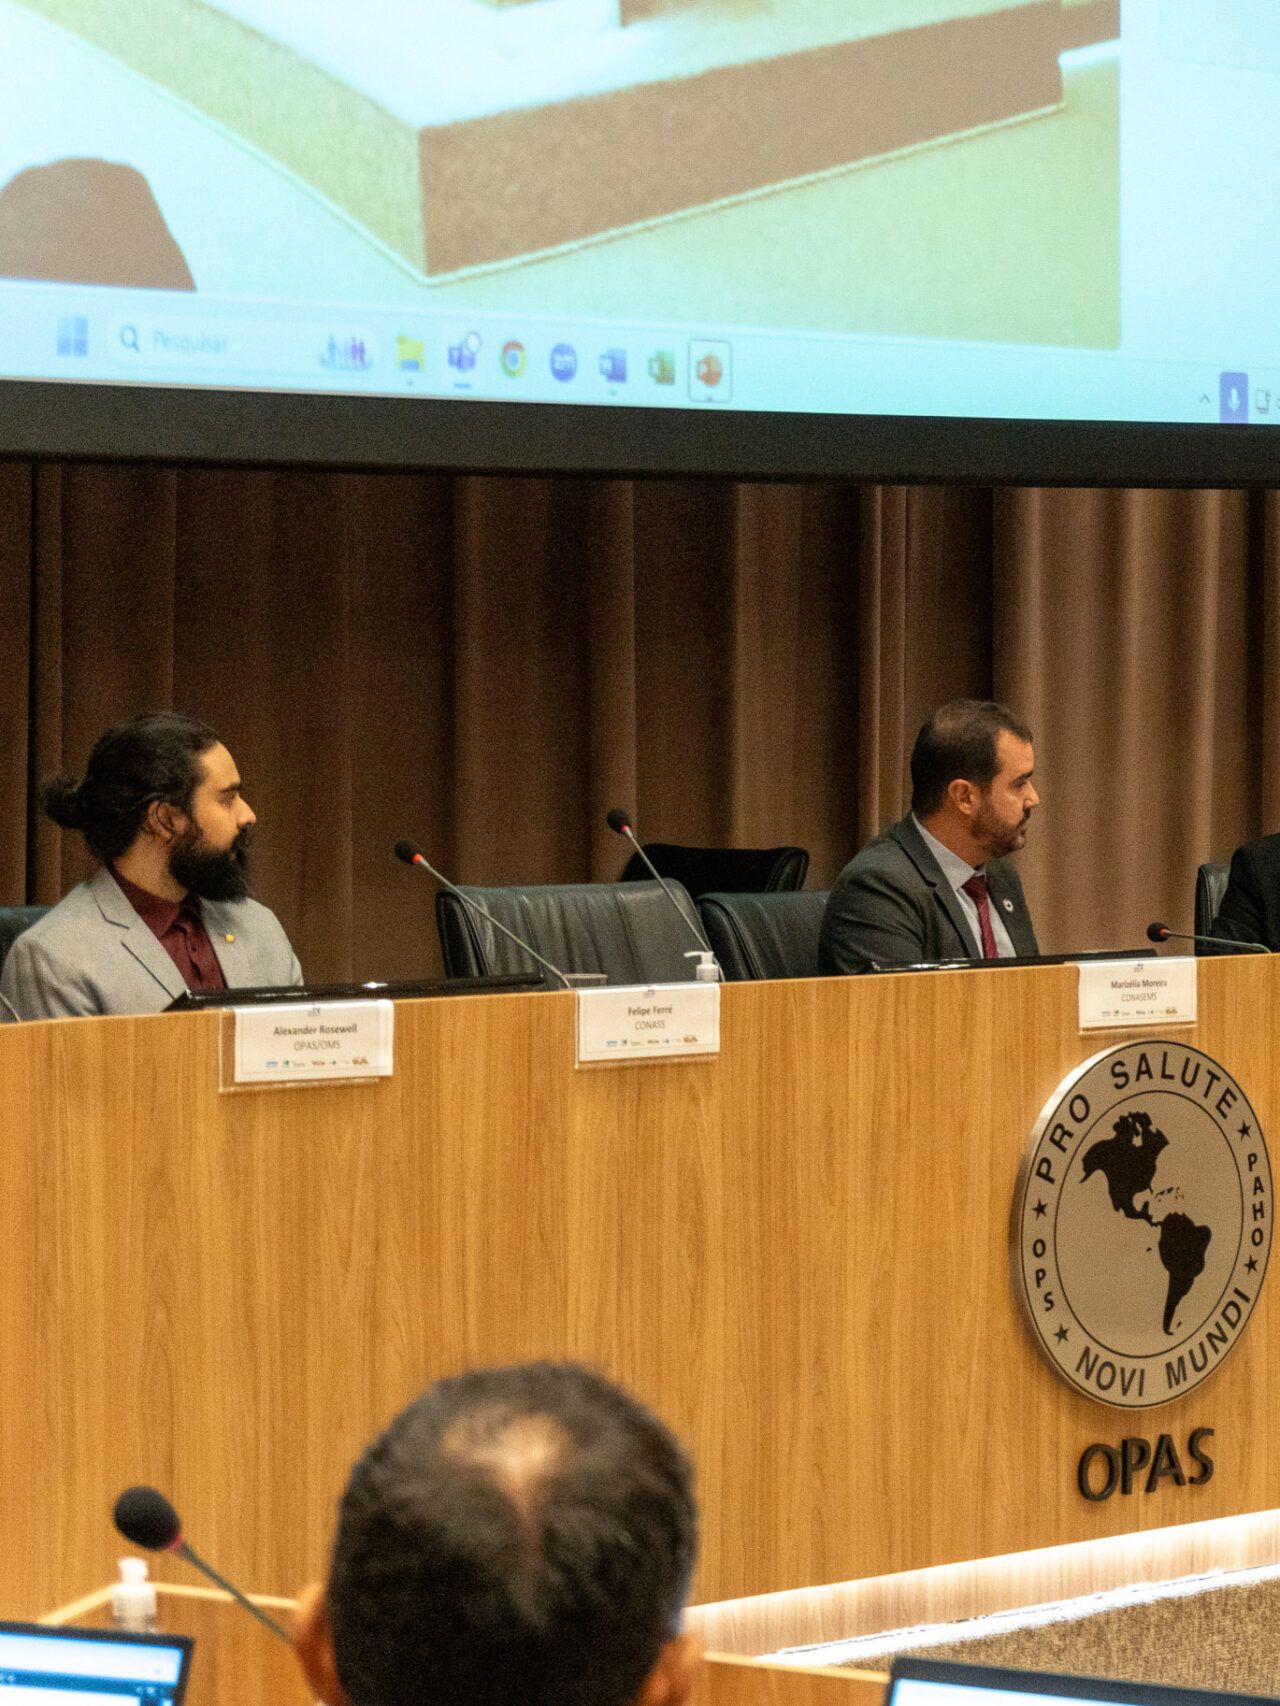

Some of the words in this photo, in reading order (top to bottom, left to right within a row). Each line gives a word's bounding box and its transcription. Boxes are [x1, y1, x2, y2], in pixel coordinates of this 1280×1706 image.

[1142, 978, 1168, 988] Moreira
[1121, 992, 1157, 1002] CONASEMS
[628, 1006, 651, 1018] Felipe
[652, 1004, 673, 1015] Ferré
[273, 1026, 318, 1037] Alexander
[319, 1023, 358, 1034] Rosewell
[634, 1020, 666, 1031] CONASS
[293, 1039, 341, 1051] OPAS/OMS
[1035, 1094, 1090, 1185] PRO
[1110, 1051, 1238, 1120] SALUTE
[1247, 1152, 1265, 1247] PAHO
[1032, 1238, 1055, 1312] OPS
[1075, 1345, 1146, 1398] NOVI
[1165, 1287, 1251, 1389] MUNDI
[1077, 1427, 1216, 1502] OPAS
